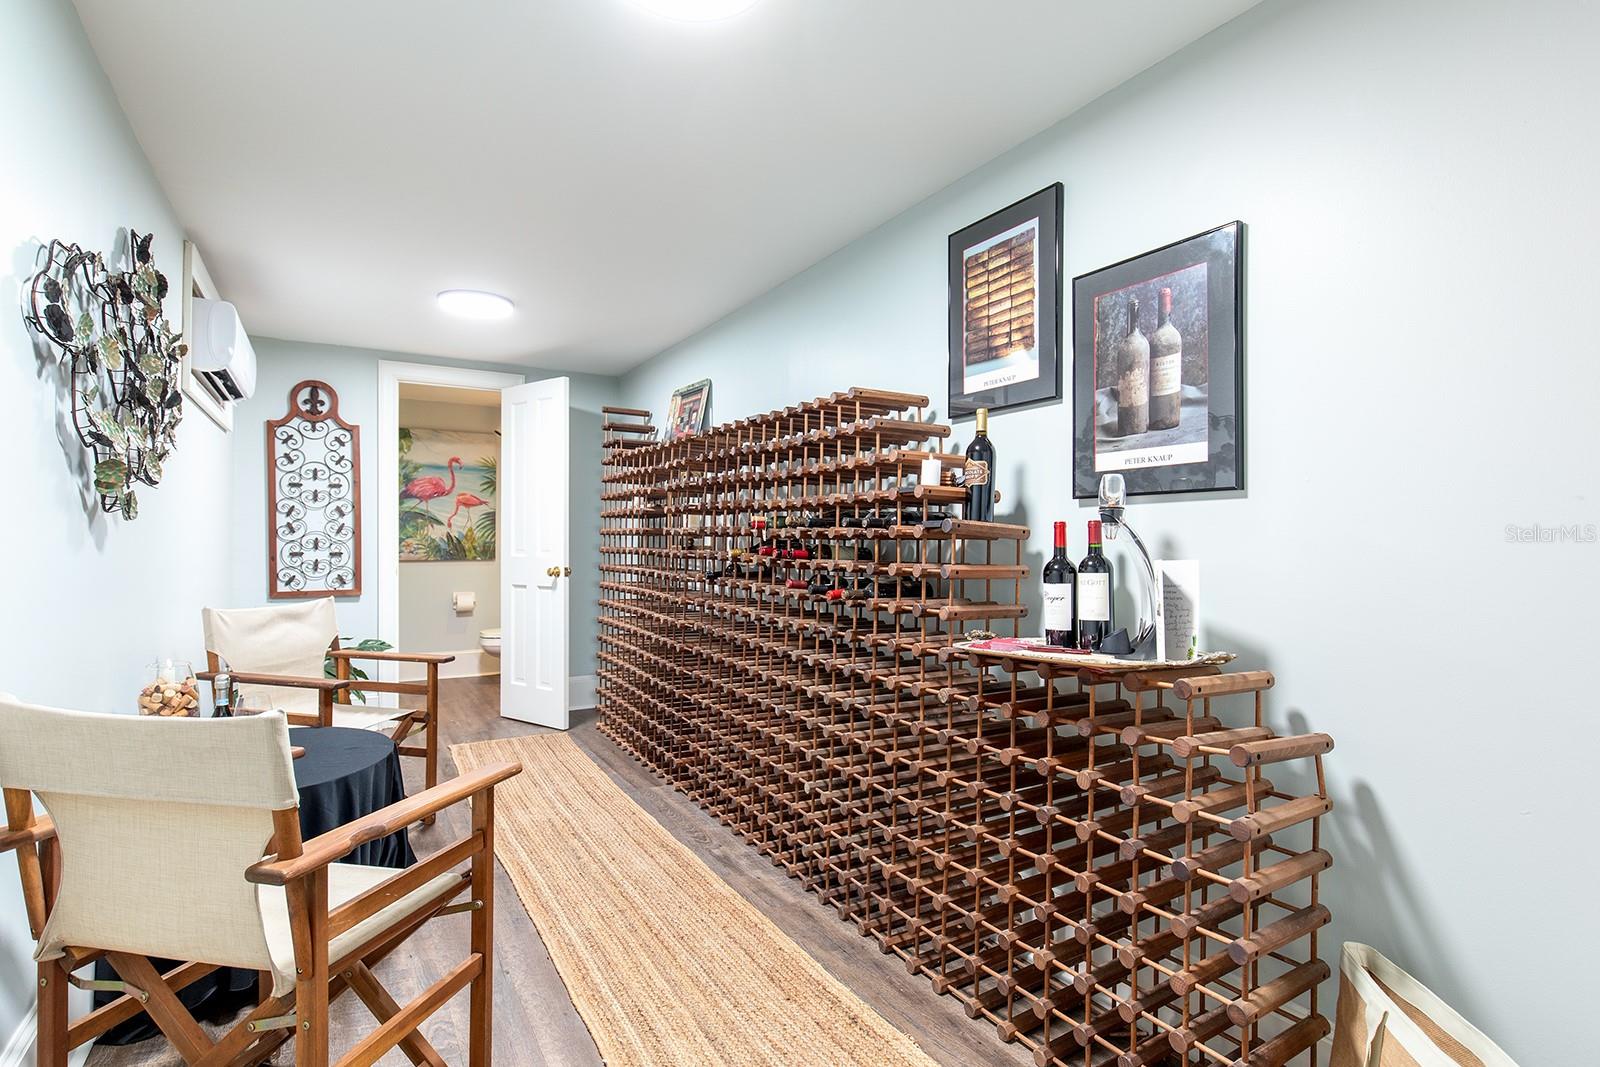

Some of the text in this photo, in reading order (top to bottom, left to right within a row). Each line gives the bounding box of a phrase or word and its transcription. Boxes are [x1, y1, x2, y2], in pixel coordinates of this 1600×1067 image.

[983, 379, 998, 387] PETER
[1124, 454, 1173, 465] PETER KNAUP
